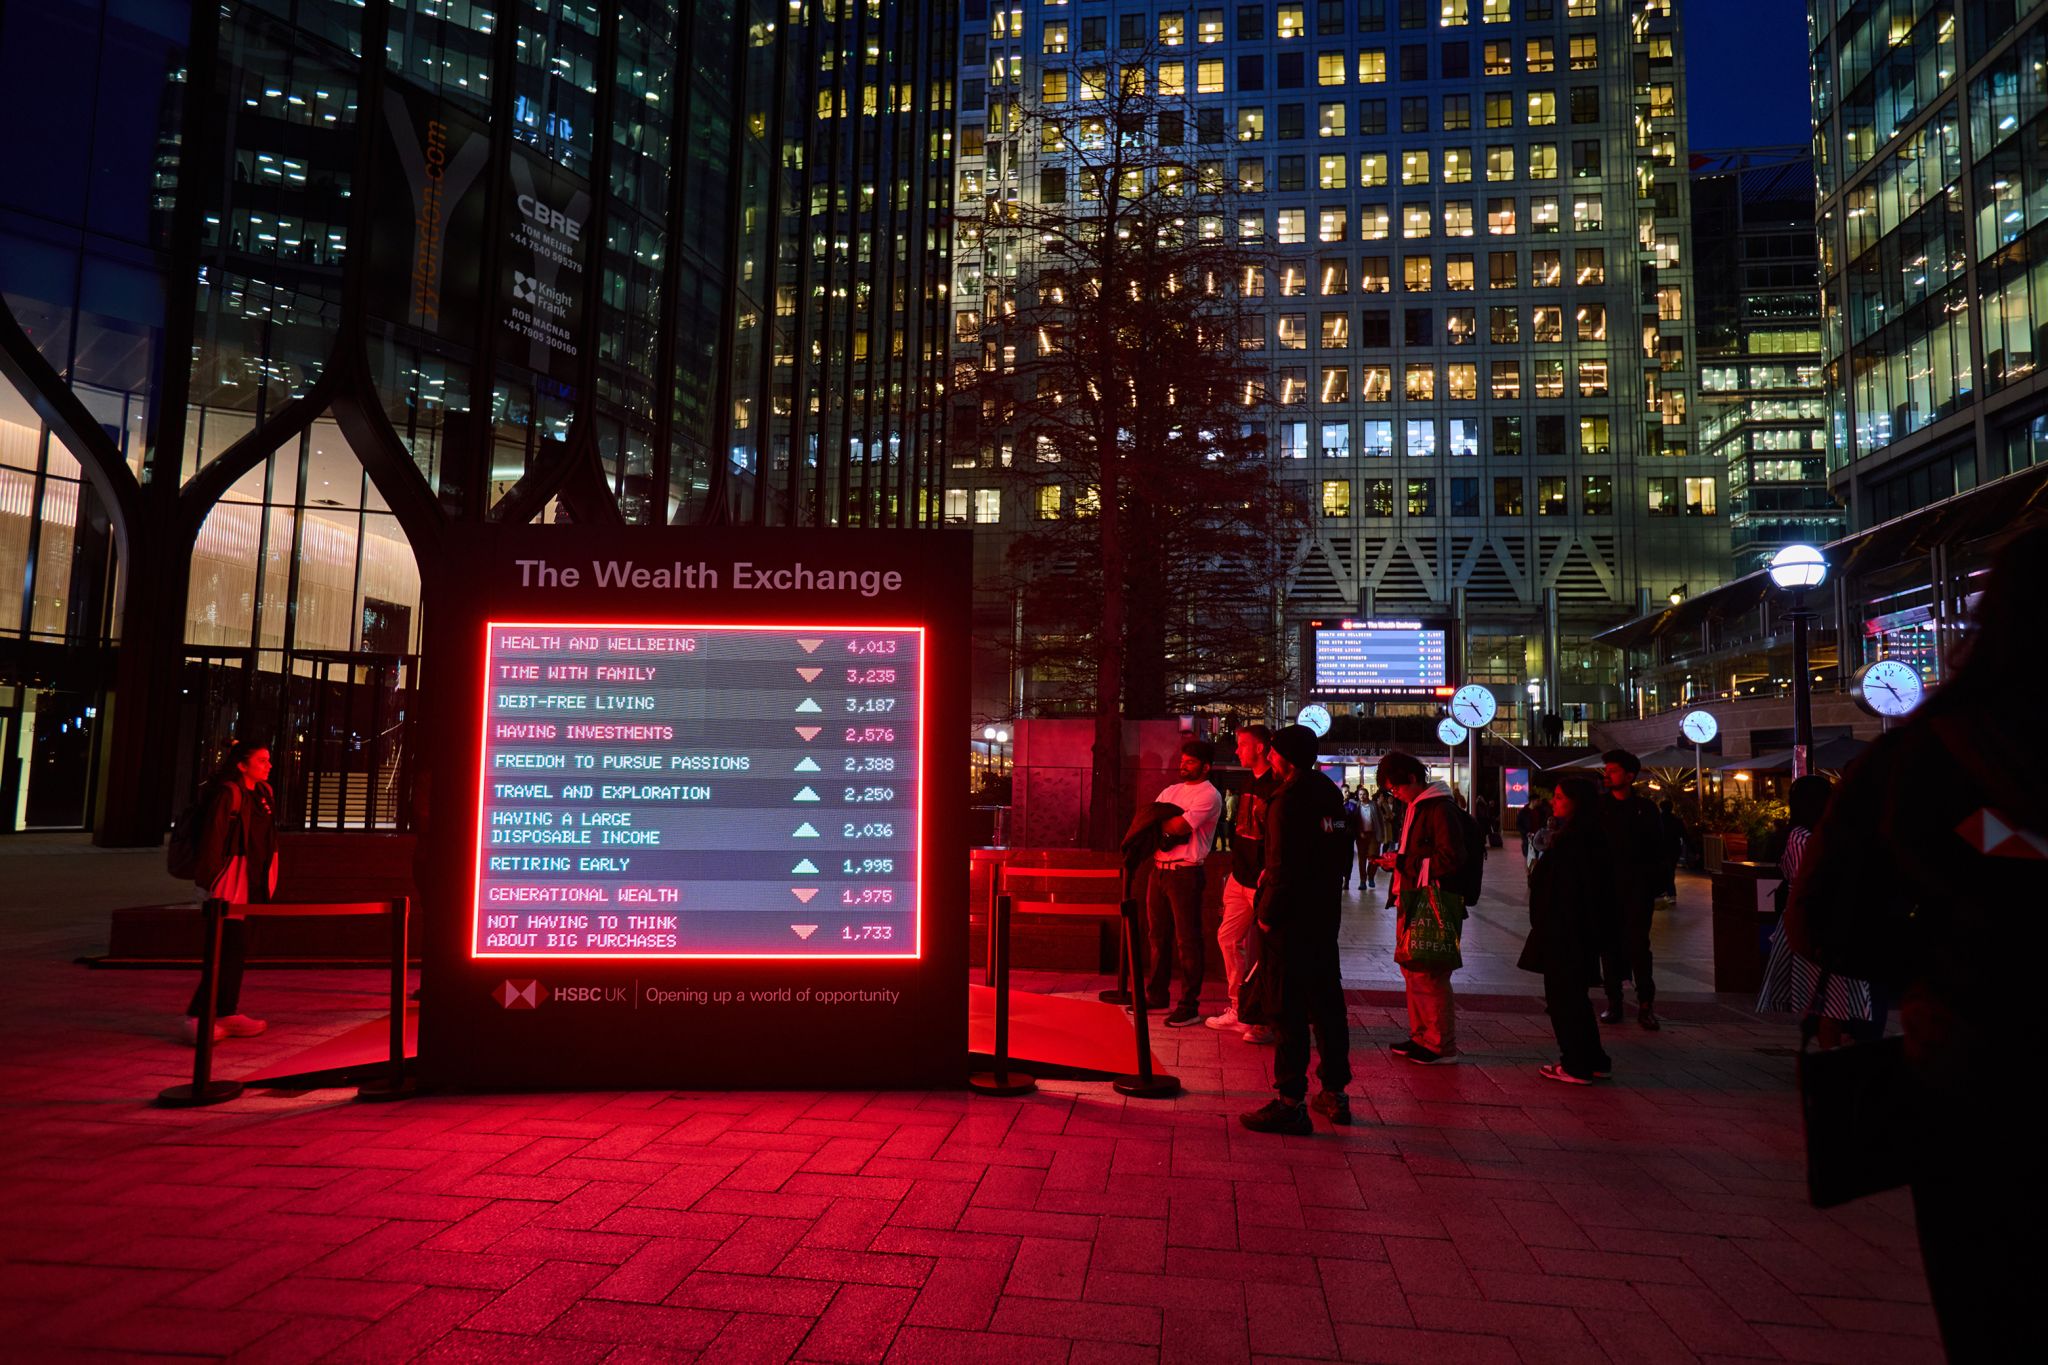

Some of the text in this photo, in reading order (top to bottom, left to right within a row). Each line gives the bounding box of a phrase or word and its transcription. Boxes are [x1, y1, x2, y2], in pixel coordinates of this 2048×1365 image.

[412, 119, 447, 319] yylondon.com
[518, 194, 580, 241] CBRE
[510, 232, 527, 246] +44
[529, 240, 550, 257] 7540
[521, 223, 573, 256] TOM MEIJER
[539, 282, 572, 307] Knight
[538, 296, 566, 319] Frank
[512, 308, 570, 340] ROB MACNAB
[503, 319, 577, 356] +44 7905 300160
[515, 560, 902, 597] The Wealth Exchange
[501, 636, 696, 651] HEALTH AND WELLBEING
[847, 641, 896, 654] 4,013
[500, 666, 656, 680] TIME WITH FAMILY
[847, 670, 895, 684] 3,235
[499, 695, 655, 710] DEBT-FREE LIVING
[846, 699, 895, 713] 3,187
[496, 725, 673, 740] HAVING INVESTMENTS
[846, 728, 894, 742] 2,576
[1338, 748, 1366, 756] SHOP
[495, 755, 750, 770] FREEDOM TO PURSUE PASSIONS
[845, 758, 894, 772] 2,388
[495, 785, 710, 800] TRAVEL AND EXPLORATION
[845, 788, 894, 802] 2,250
[492, 812, 631, 826] HAVING A LARGE
[492, 830, 660, 844] DISPOSABLE INCOME
[844, 824, 893, 838] 2,036
[490, 857, 630, 871] RETIRING EARLY
[844, 860, 893, 874] 1,995
[490, 888, 679, 902] GENERATIONAL WEALTH
[843, 890, 892, 904] 1,975
[487, 916, 677, 929] NOT HAVING TO THINK
[842, 926, 892, 940] 1,733
[487, 934, 677, 947] ABOUT BIG PURCHASES
[555, 987, 626, 1001] HSBC UK
[646, 987, 900, 1004] Opening up a world of opportunity
